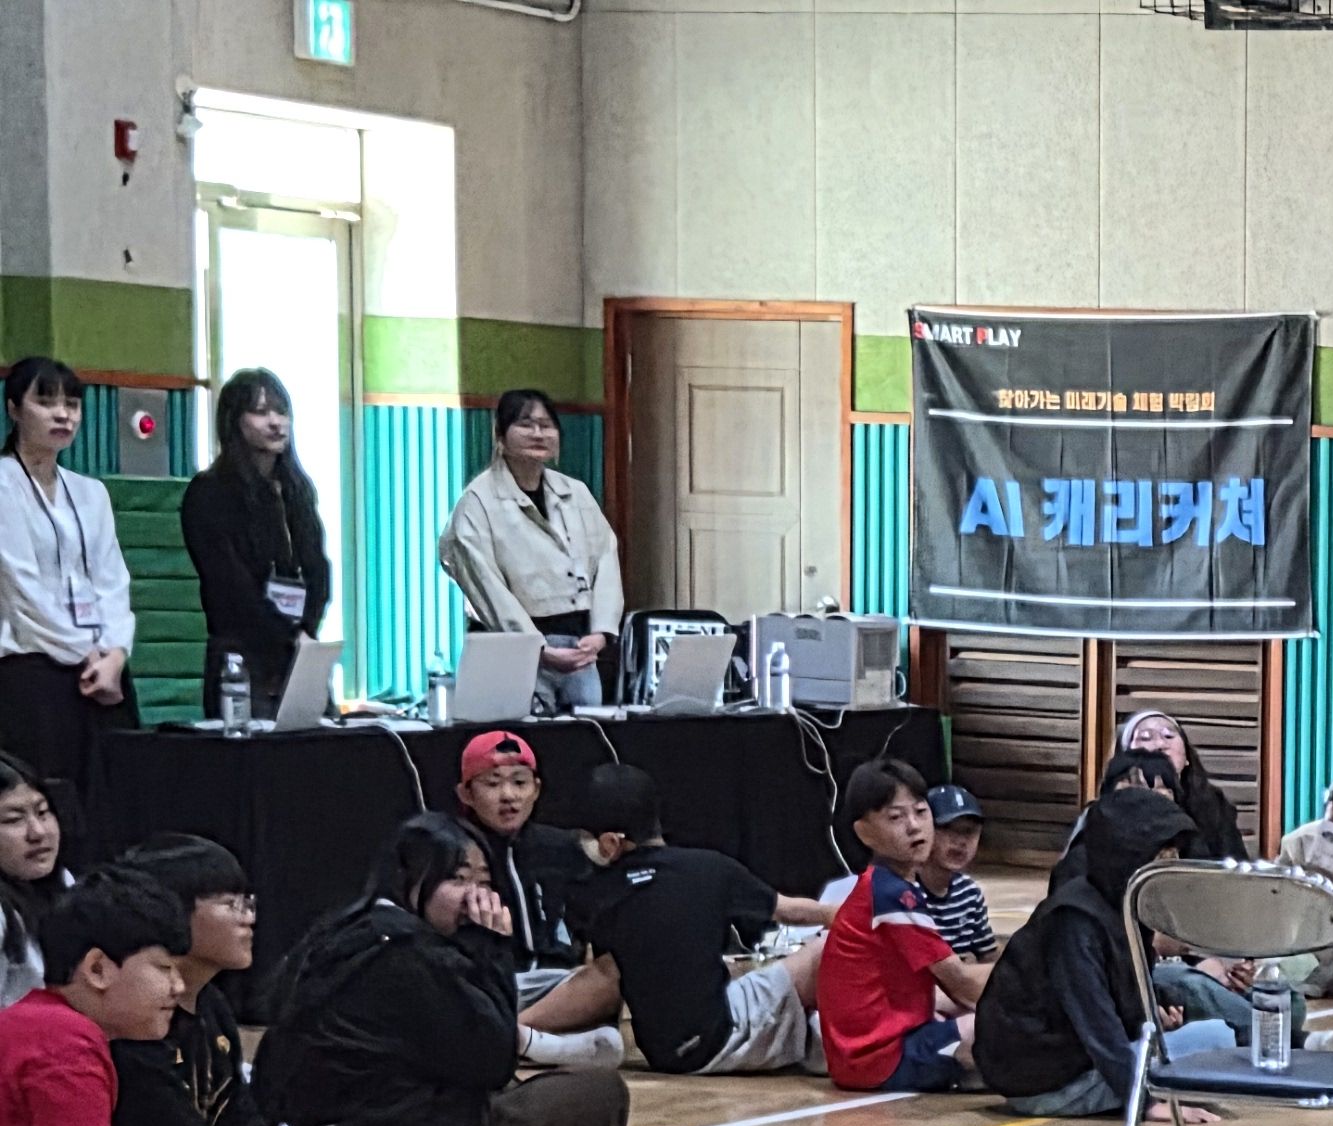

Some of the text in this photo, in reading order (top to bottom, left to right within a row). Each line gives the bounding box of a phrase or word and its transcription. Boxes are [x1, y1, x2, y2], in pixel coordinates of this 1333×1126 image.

[913, 321, 1021, 347] SMART PLAY
[998, 388, 1215, 412] 찾아가는 미래기술 체험 박람회
[960, 477, 1266, 547] AI 캐리커쳐
